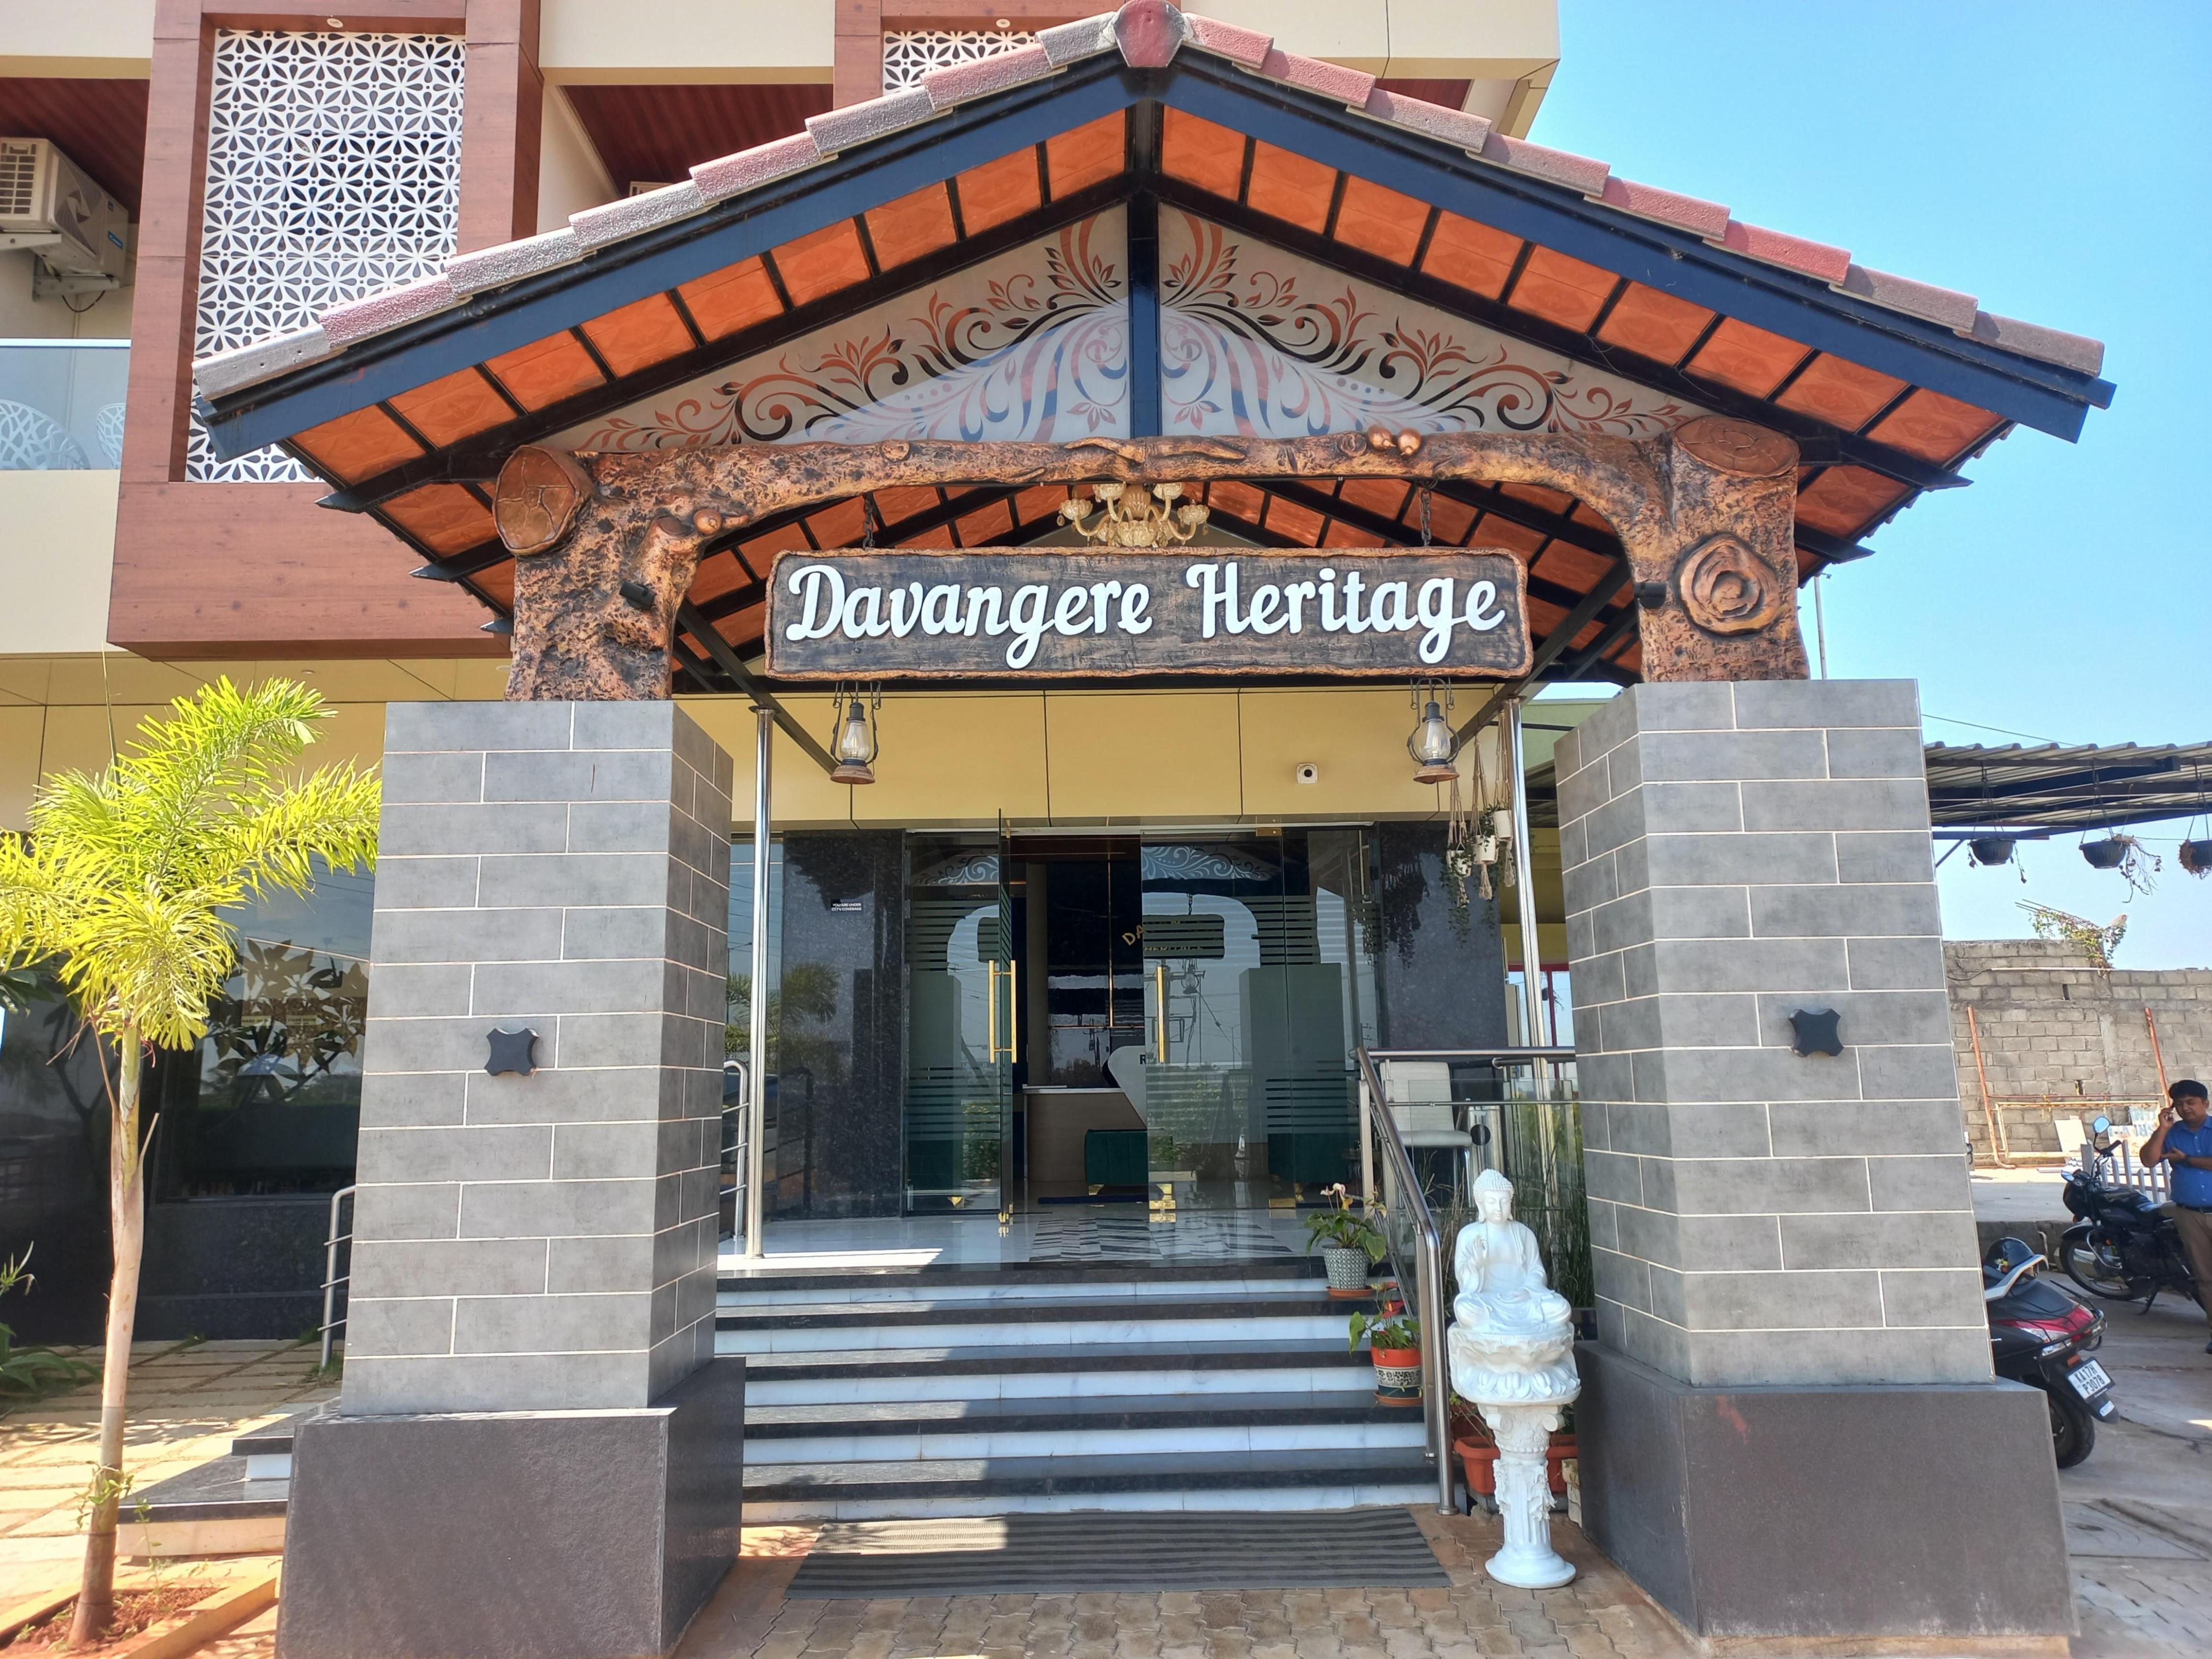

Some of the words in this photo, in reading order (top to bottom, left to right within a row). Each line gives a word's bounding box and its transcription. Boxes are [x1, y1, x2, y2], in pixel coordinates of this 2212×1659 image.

[786, 564, 1152, 669] Davangere
[1186, 562, 1506, 664] Heritage
[2074, 1363, 2097, 1383] KA17H
[2082, 1374, 2105, 1395] P3078
